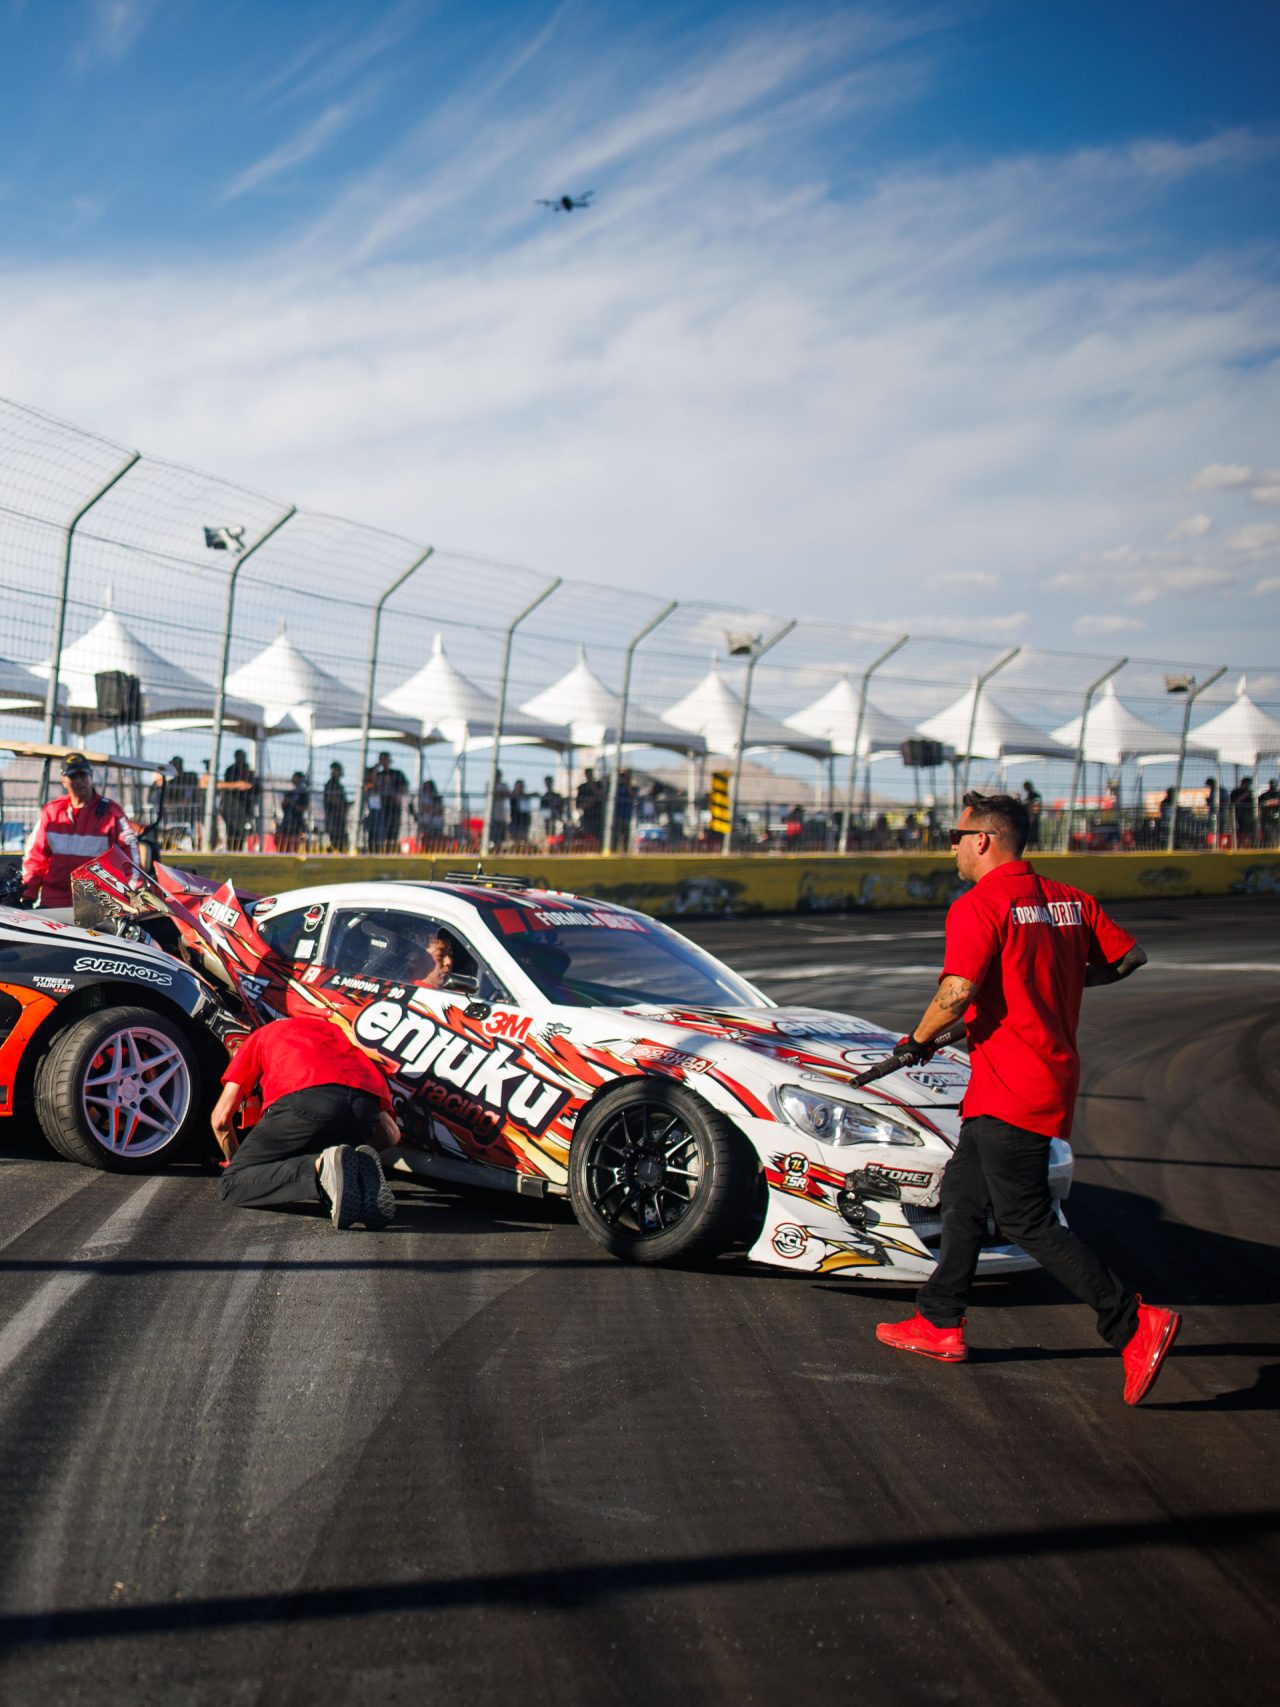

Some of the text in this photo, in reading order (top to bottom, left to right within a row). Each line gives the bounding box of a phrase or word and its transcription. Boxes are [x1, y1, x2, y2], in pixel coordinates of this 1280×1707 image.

[534, 911, 606, 927] FORMULA
[32, 976, 72, 985] STREET
[73, 957, 173, 986] SUBIMODS
[36, 982, 76, 991] HUNTER
[340, 976, 380, 994] MINOWA
[389, 987, 406, 999] 90
[485, 1011, 533, 1040] 3M
[355, 1000, 563, 1128] enjuku
[420, 1079, 501, 1135] racing
[879, 1168, 930, 1183] TOMEI
[773, 1233, 808, 1251] ACL
